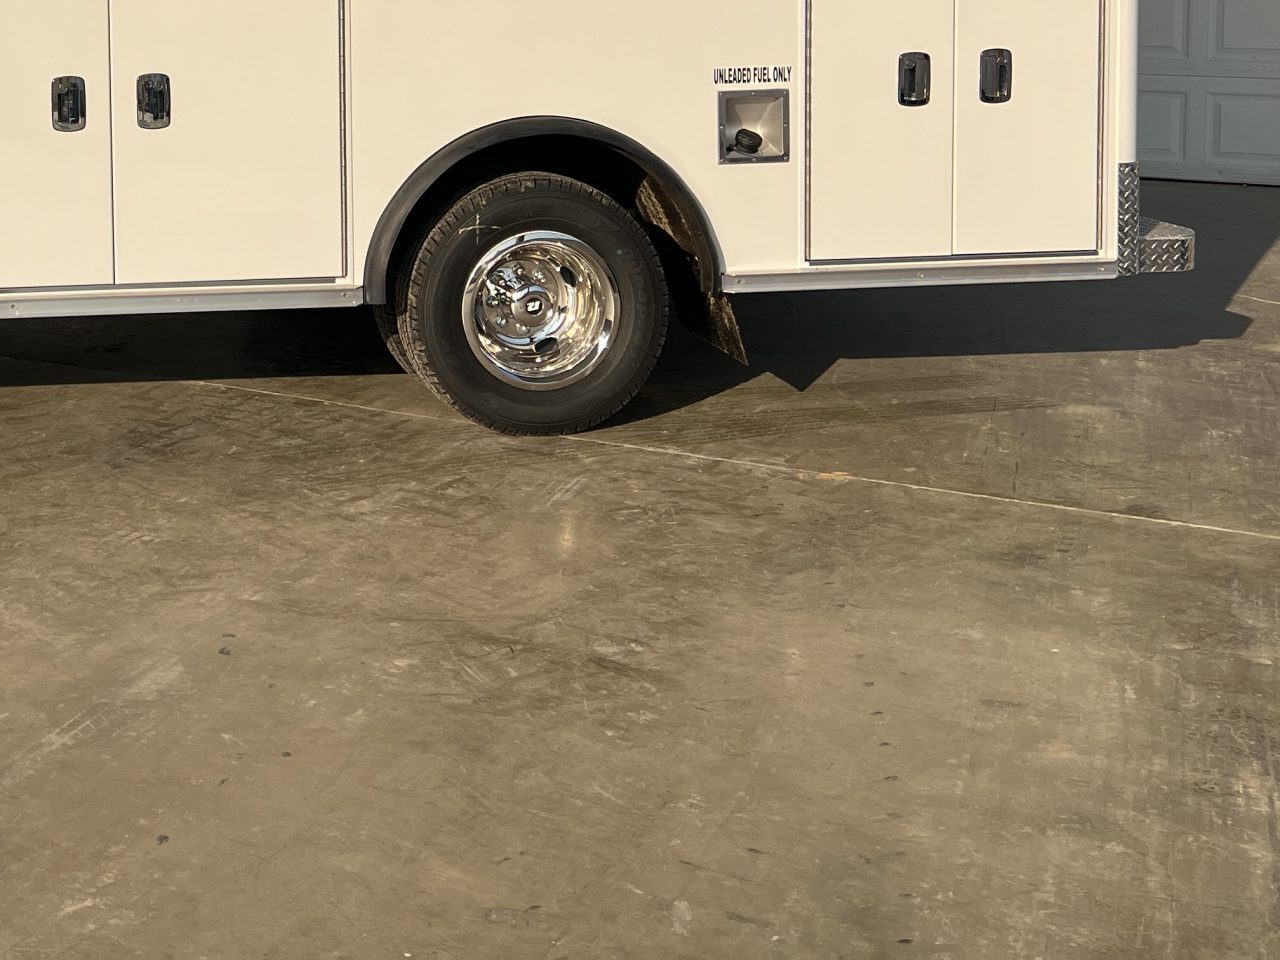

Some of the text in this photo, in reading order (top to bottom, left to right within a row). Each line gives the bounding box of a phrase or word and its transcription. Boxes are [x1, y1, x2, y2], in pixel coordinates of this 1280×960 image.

[713, 66, 792, 85] UNLEADED FUEL ONLY
